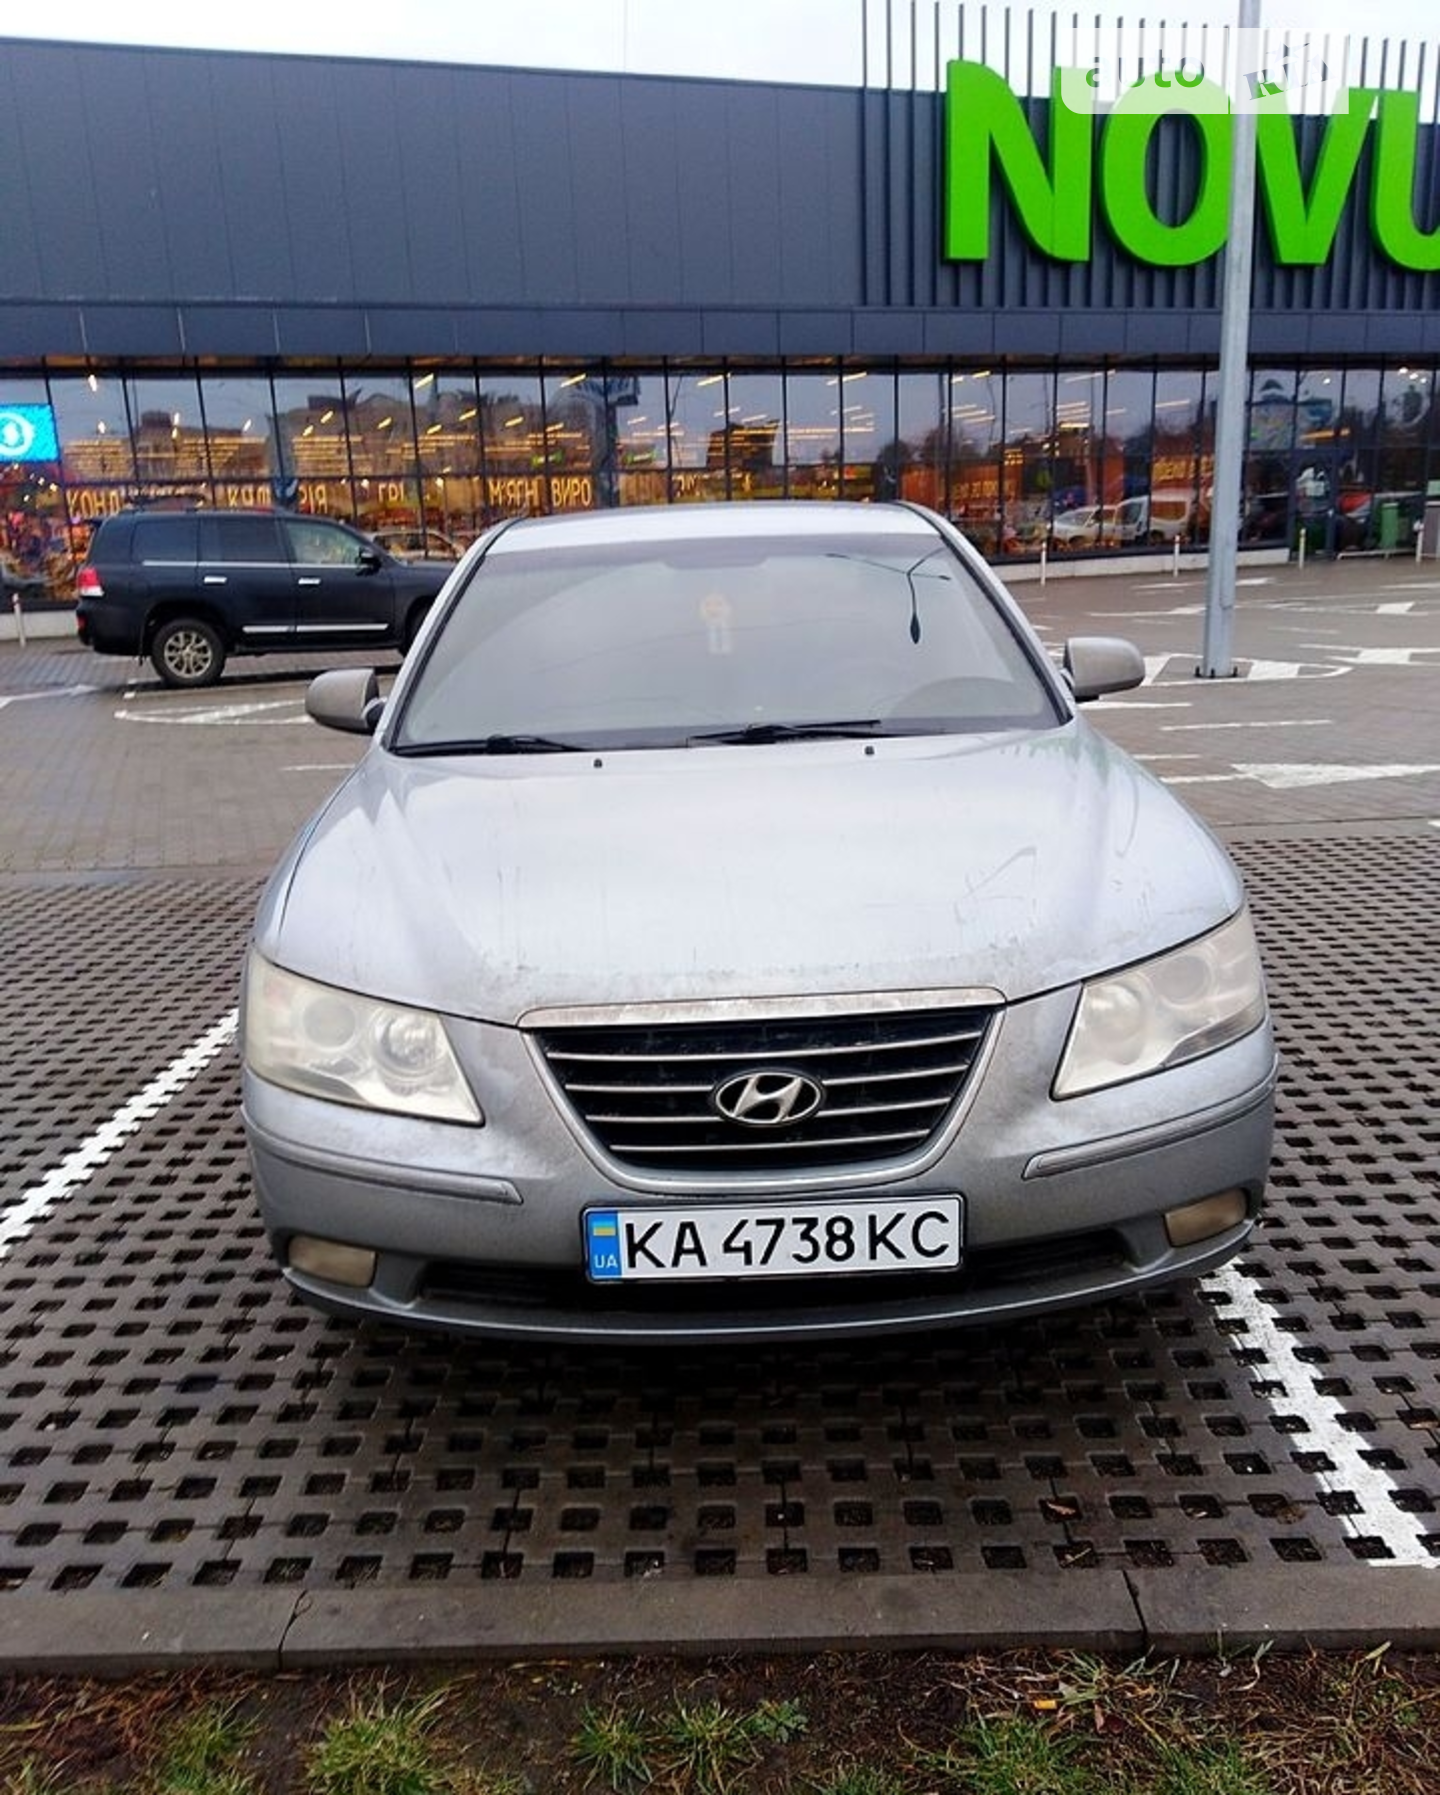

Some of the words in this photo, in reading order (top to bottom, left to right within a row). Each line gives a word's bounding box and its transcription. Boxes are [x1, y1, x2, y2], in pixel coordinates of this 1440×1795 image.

[625, 1221, 707, 1268] KA
[722, 1215, 855, 1266] 4738
[868, 1210, 950, 1260] KC
[594, 1254, 618, 1268] UA
